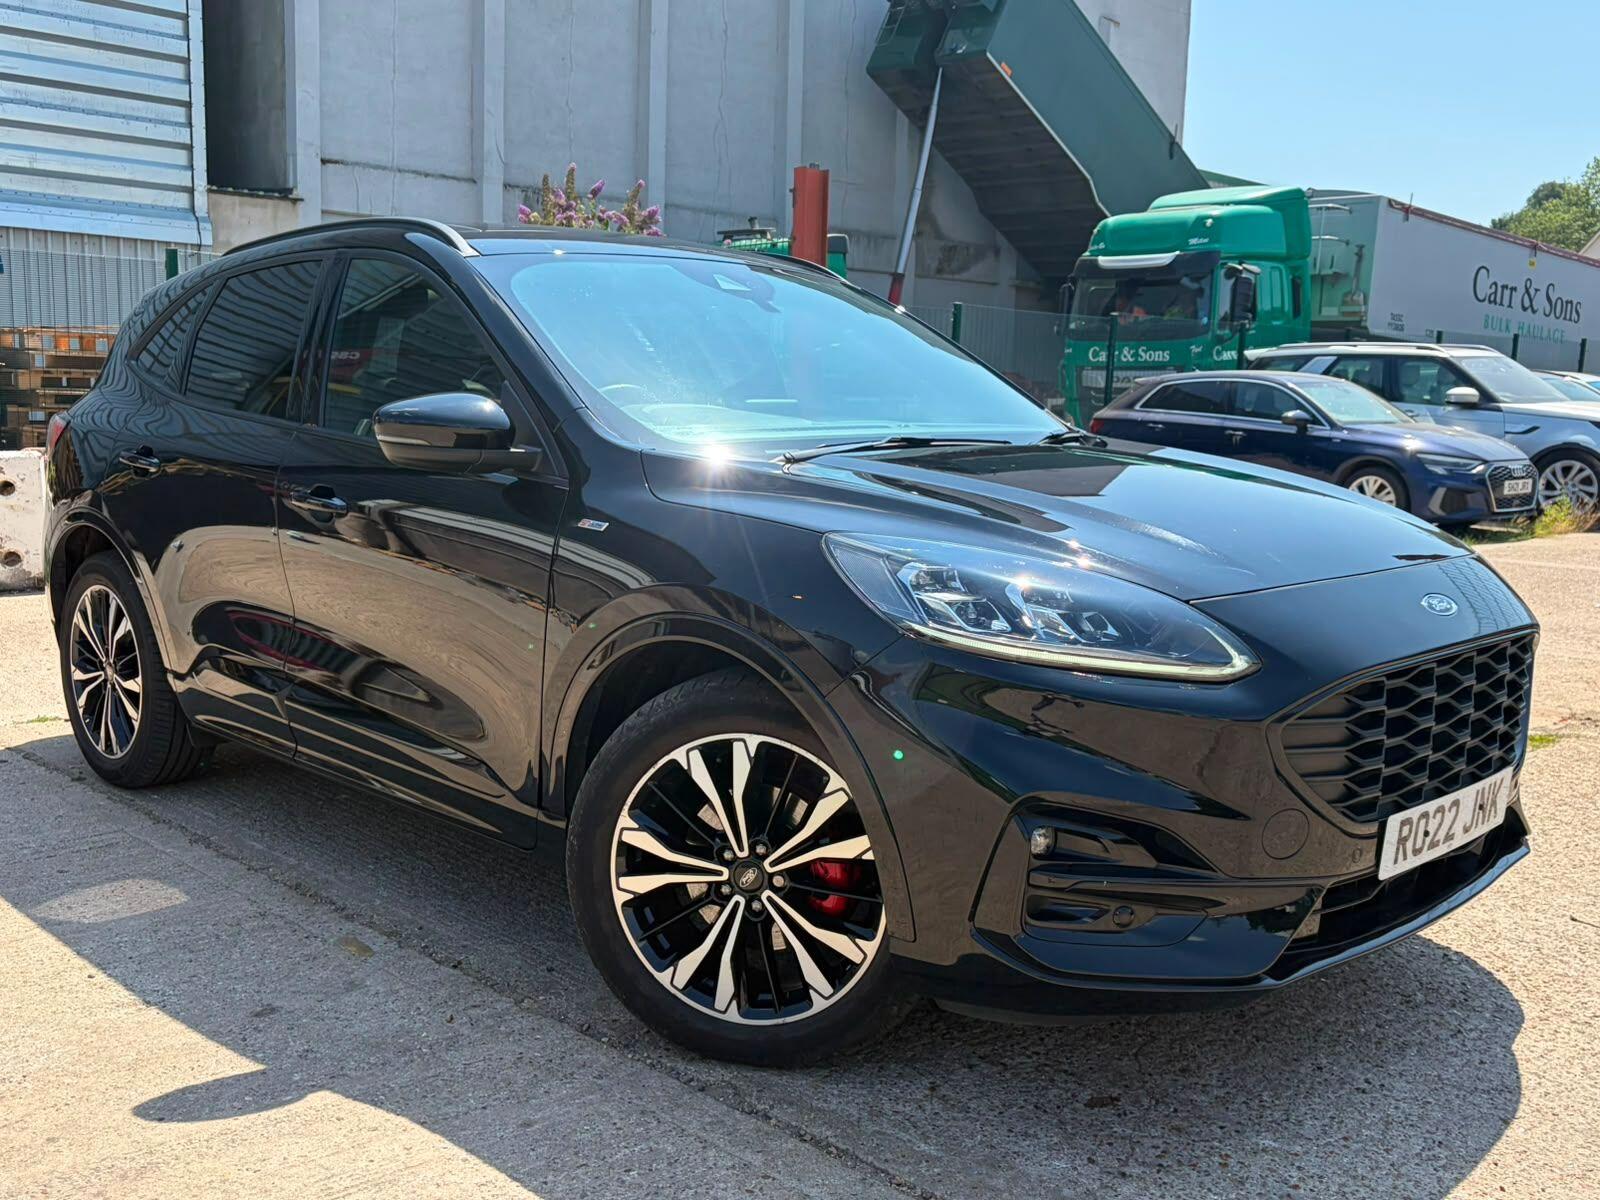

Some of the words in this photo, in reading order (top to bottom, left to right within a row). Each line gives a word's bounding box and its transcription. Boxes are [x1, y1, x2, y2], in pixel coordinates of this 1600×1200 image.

[1473, 265, 1517, 309] Carr
[1521, 277, 1540, 314] &
[1543, 282, 1582, 324] Sons
[1483, 313, 1512, 334] BULK
[1518, 321, 1566, 344] HAULAGE
[1088, 346, 1119, 361] Car
[1121, 346, 1136, 361] &
[1137, 346, 1170, 361] Sons
[1393, 798, 1460, 865] RO22
[1462, 778, 1504, 834] JNK
